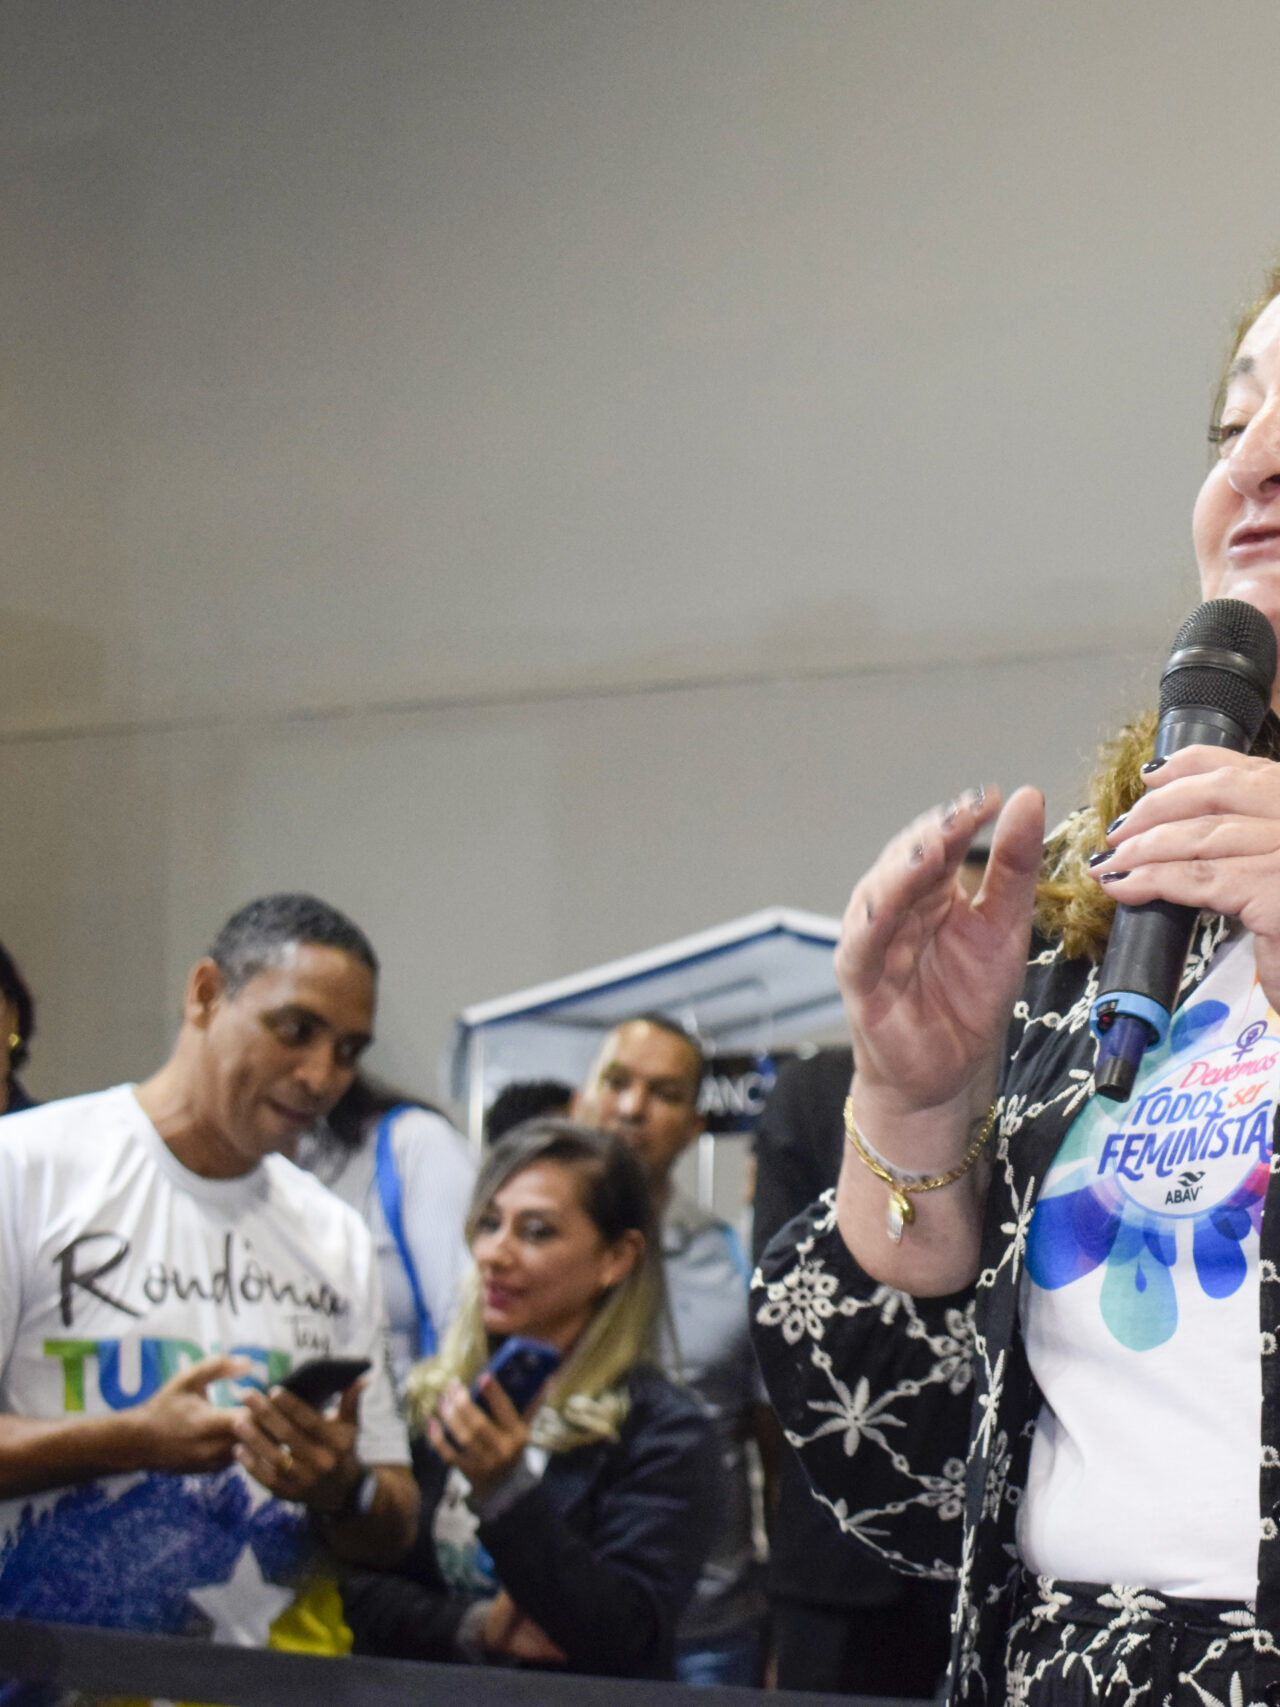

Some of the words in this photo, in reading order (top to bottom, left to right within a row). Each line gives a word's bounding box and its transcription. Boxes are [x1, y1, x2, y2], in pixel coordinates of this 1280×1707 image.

[1180, 1052, 1279, 1089] Devemos
[1132, 1087, 1228, 1126] TODOS
[1228, 1081, 1270, 1108] ser
[1165, 1187, 1200, 1205] ABAV
